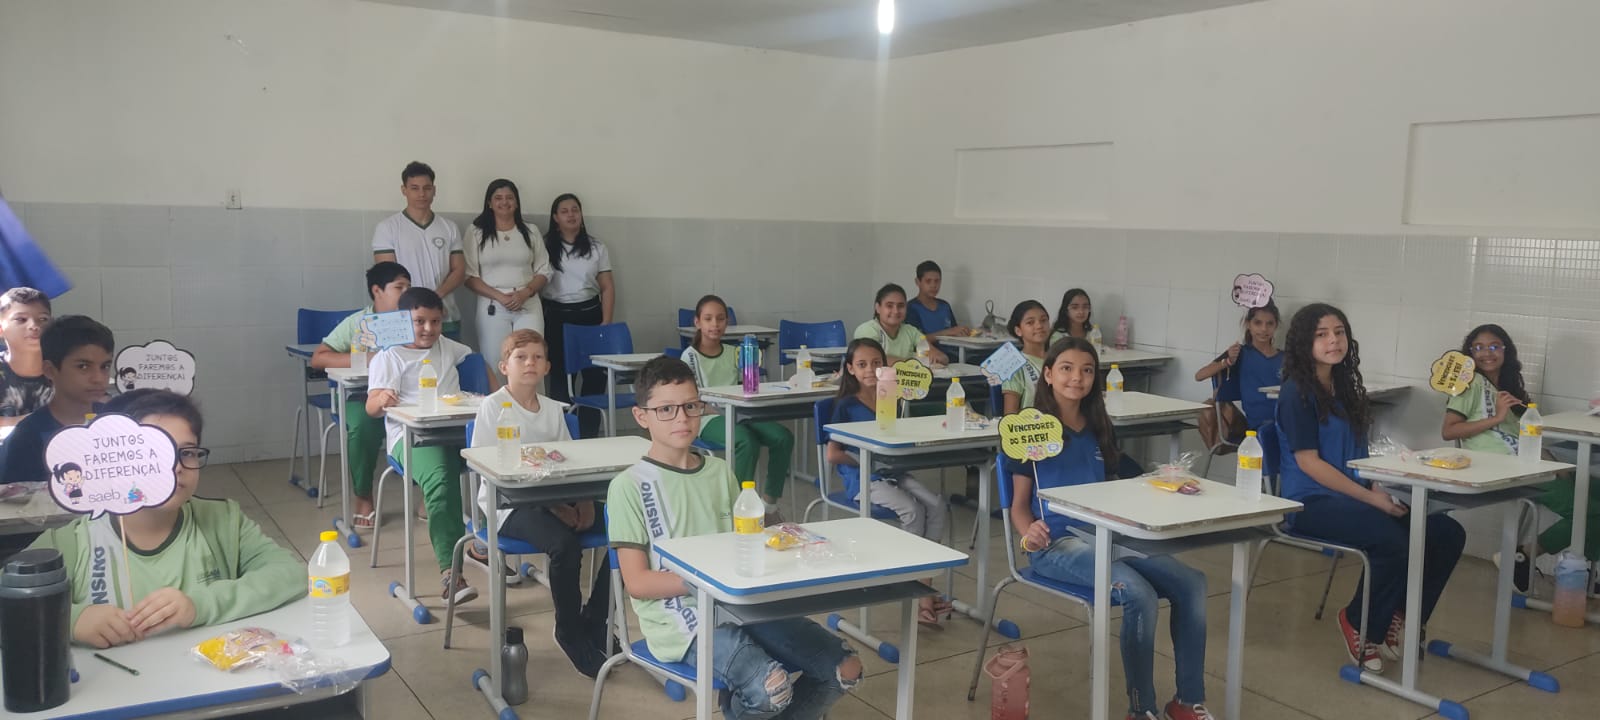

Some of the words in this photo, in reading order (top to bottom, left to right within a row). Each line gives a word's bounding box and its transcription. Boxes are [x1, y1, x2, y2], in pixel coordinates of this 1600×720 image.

[1008, 422, 1055, 433] VENCEDORES
[93, 434, 144, 450] JUNTOS
[1021, 433, 1049, 444] SAEB!
[84, 449, 144, 466] FAREMOS
[149, 448, 158, 459] A
[84, 462, 160, 480] DIFERENÇA!
[88, 489, 120, 502] saeb
[641, 482, 664, 538] ENSINO
[91, 546, 109, 605] NSINO
